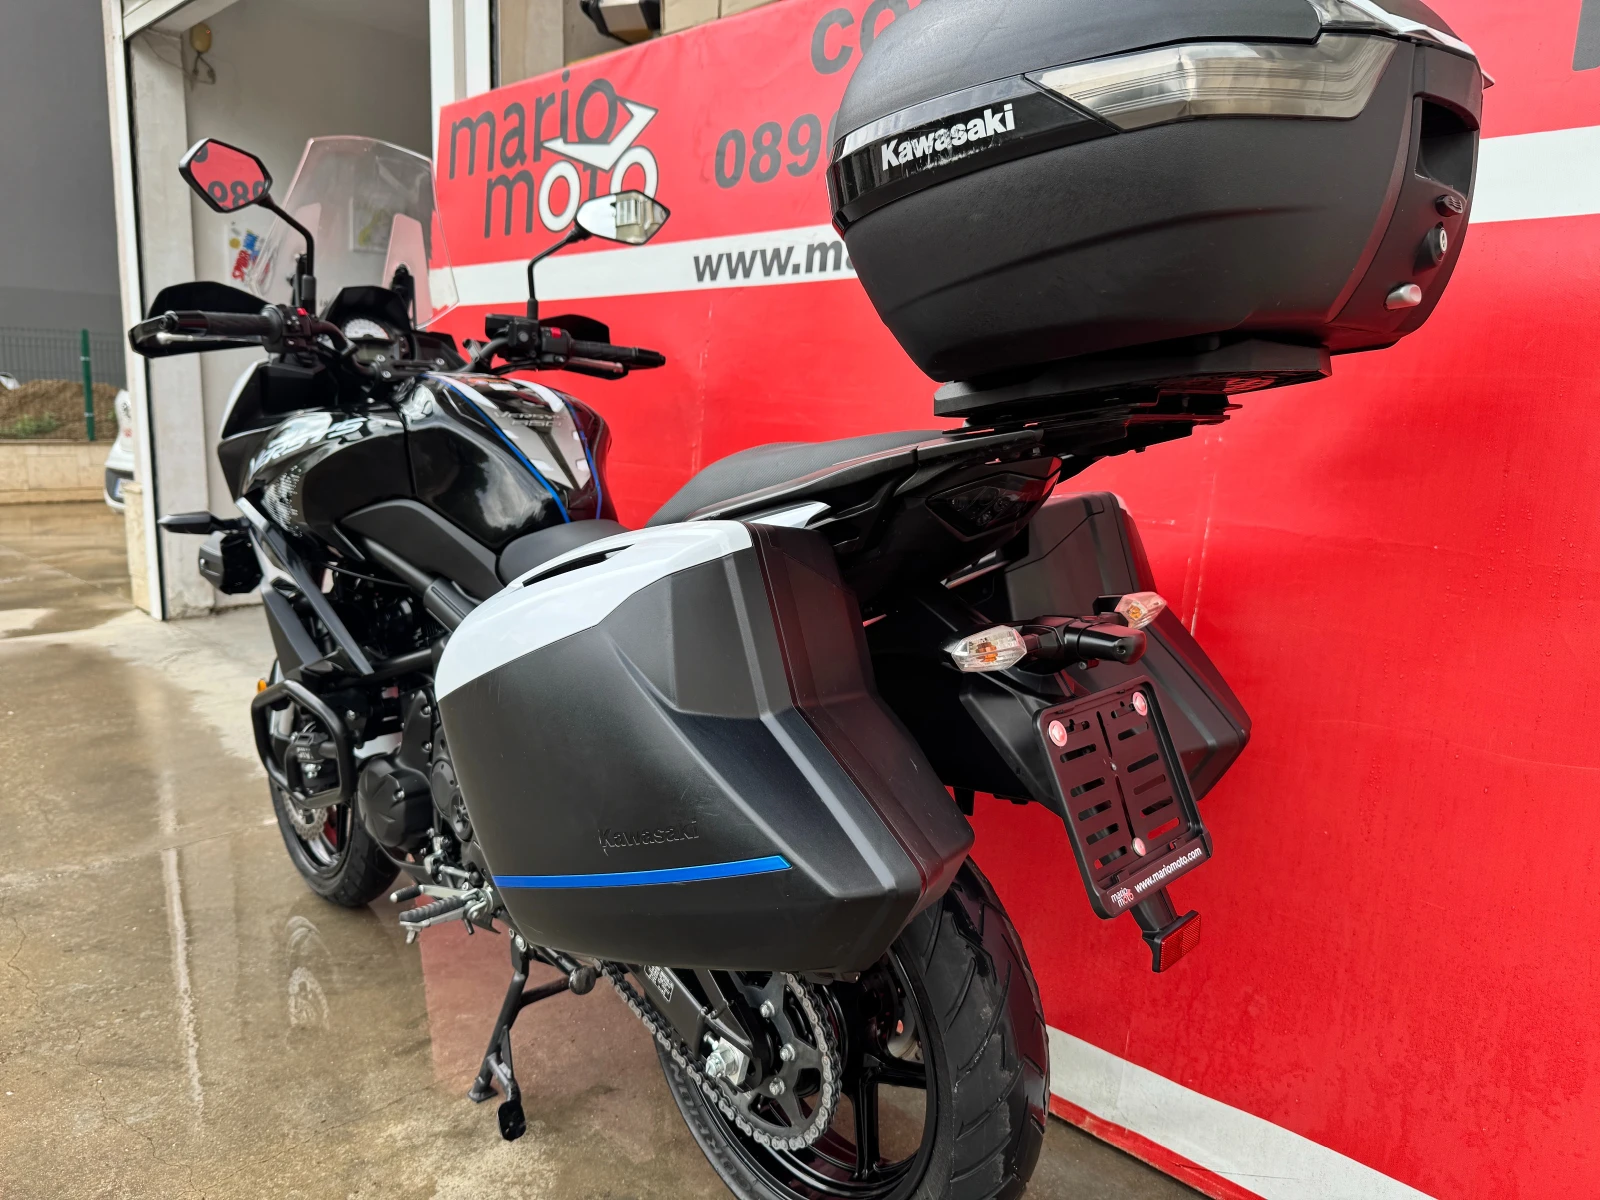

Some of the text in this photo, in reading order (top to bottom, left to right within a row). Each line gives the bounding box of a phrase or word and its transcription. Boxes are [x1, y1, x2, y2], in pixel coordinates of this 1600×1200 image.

[449, 70, 618, 180] mario
[715, 112, 839, 189] 089
[881, 103, 1016, 171] Kawasaki
[598, 819, 700, 848] Kawasaki
[1110, 887, 1129, 903] mario
[1134, 847, 1202, 893] www.mariomoto.com
